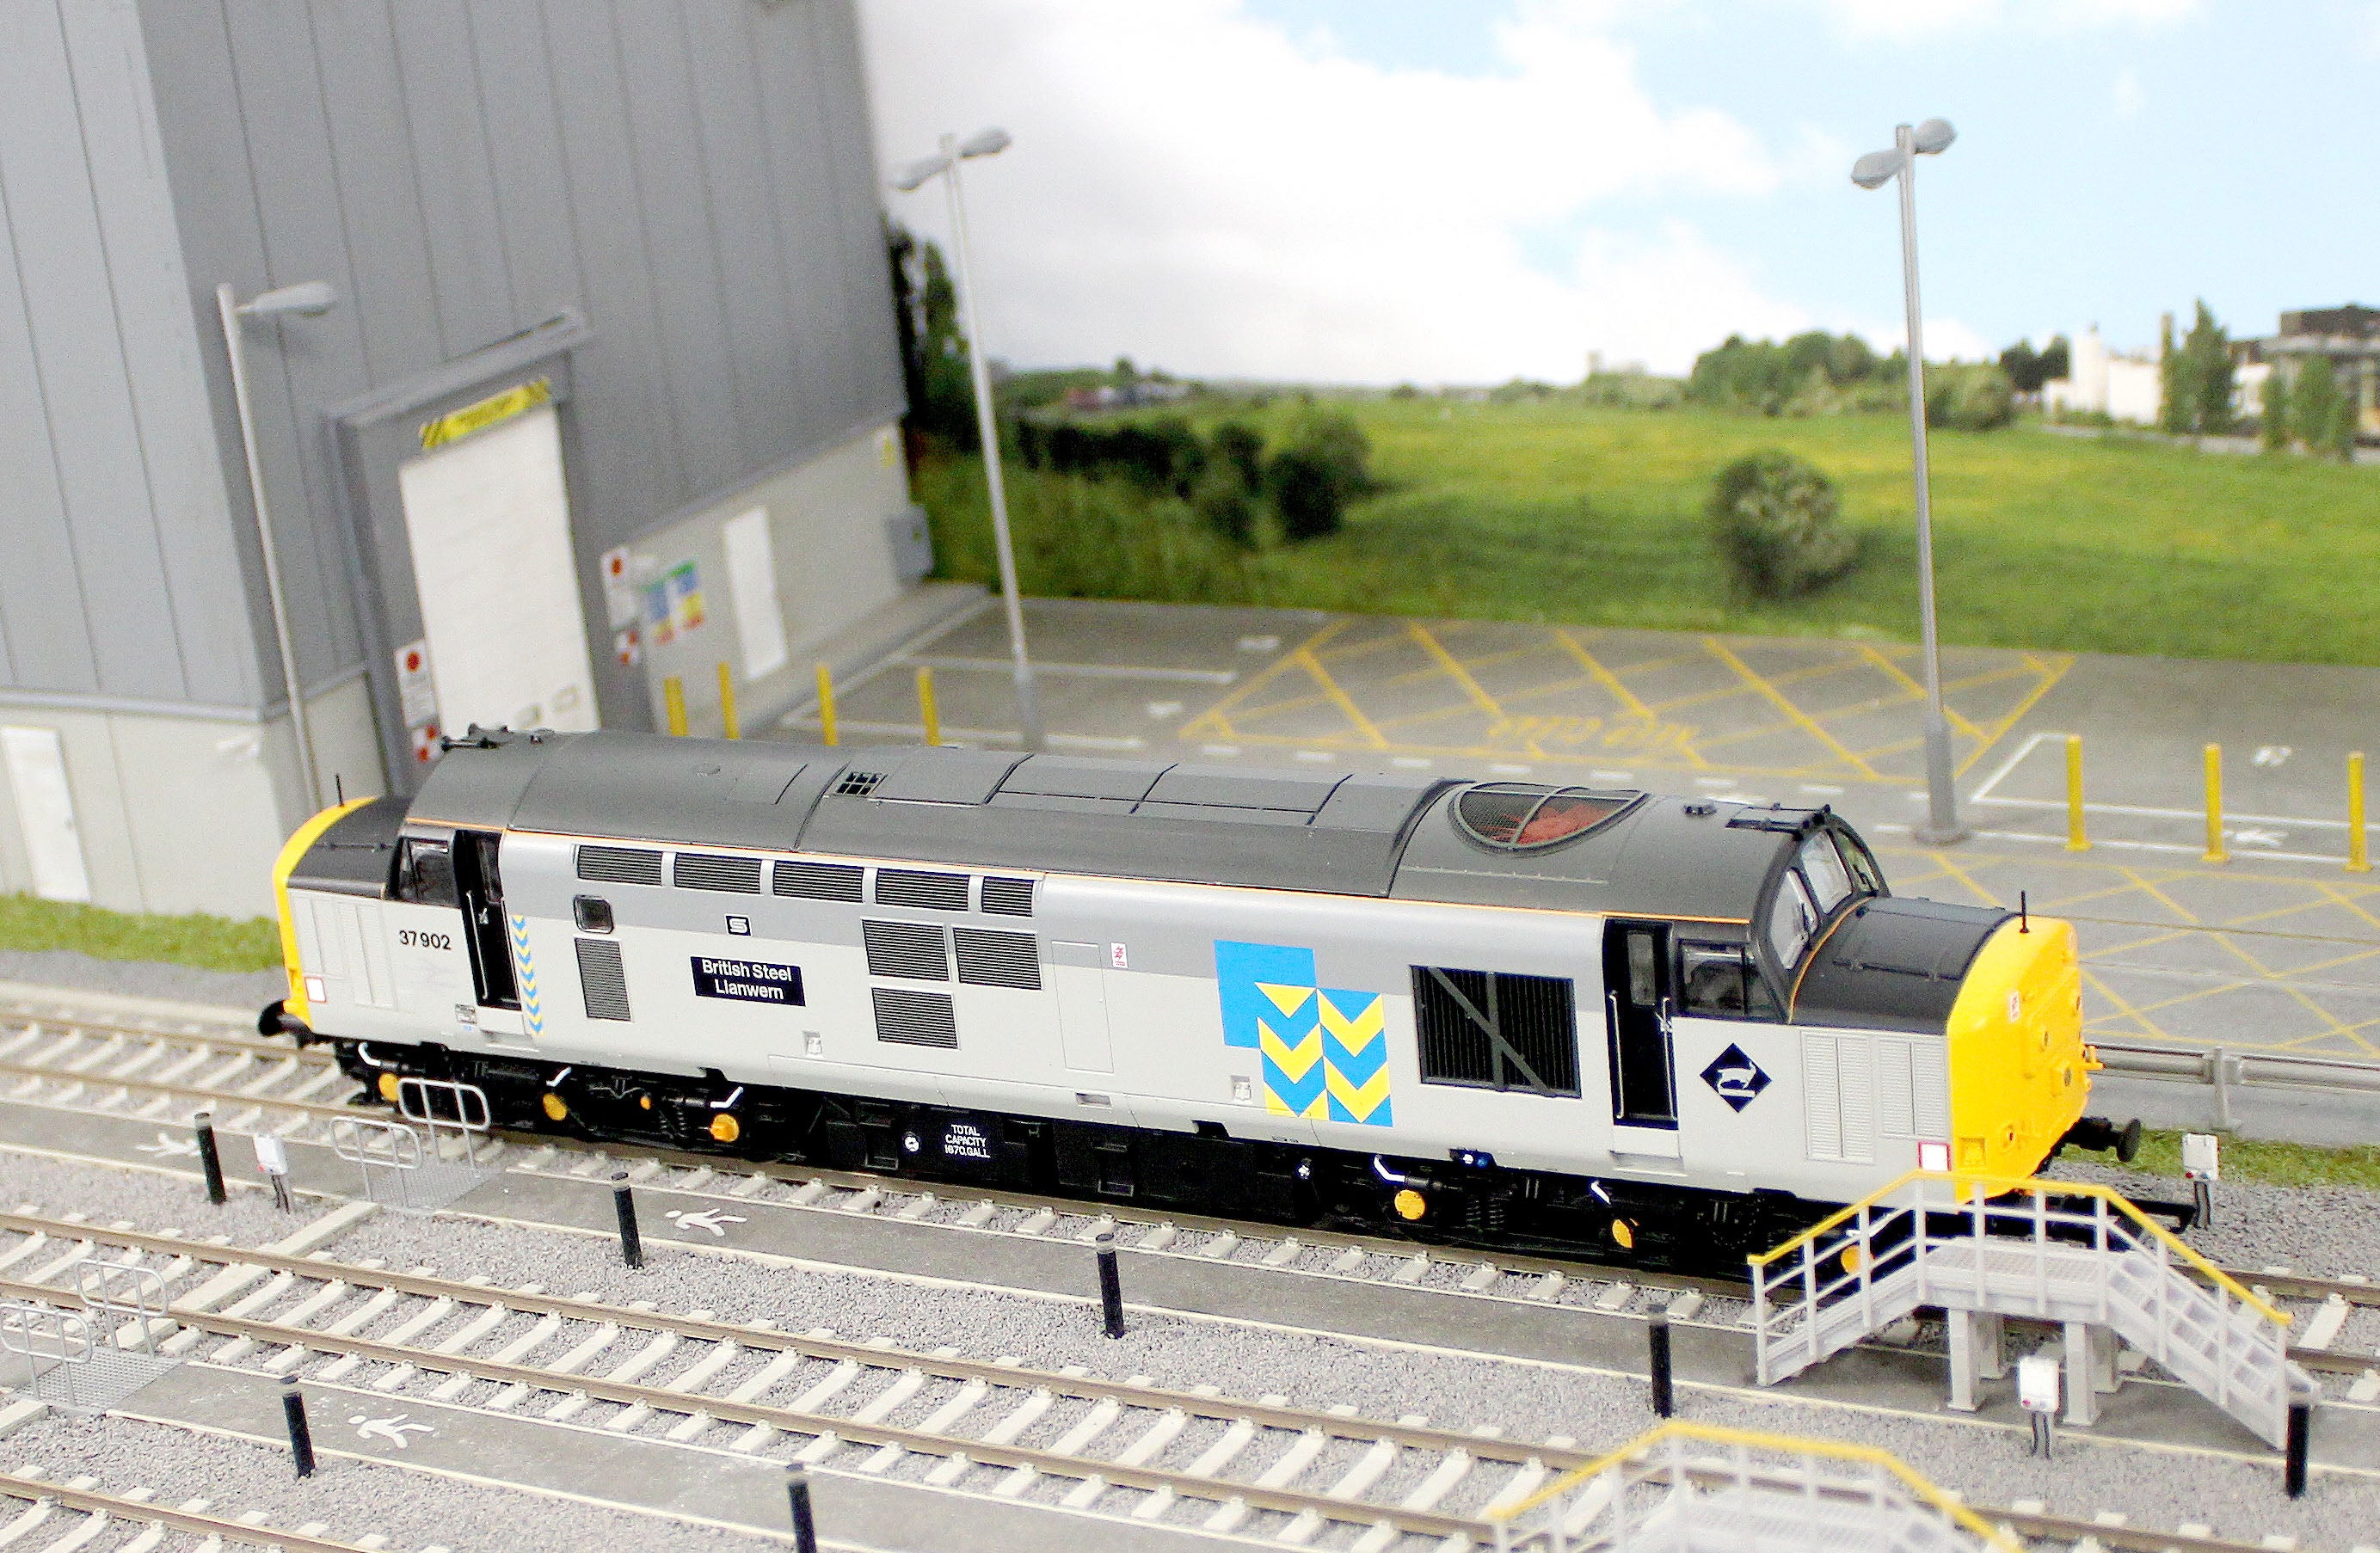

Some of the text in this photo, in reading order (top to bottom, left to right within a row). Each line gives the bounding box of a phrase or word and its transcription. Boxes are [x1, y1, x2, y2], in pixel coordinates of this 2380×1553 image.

[399, 930, 452, 950] 37902
[701, 958, 792, 982] British Steel
[714, 978, 784, 1000] Llanwern
[950, 1124, 981, 1136] TOTAL
[944, 1133, 987, 1148] CAPACITY
